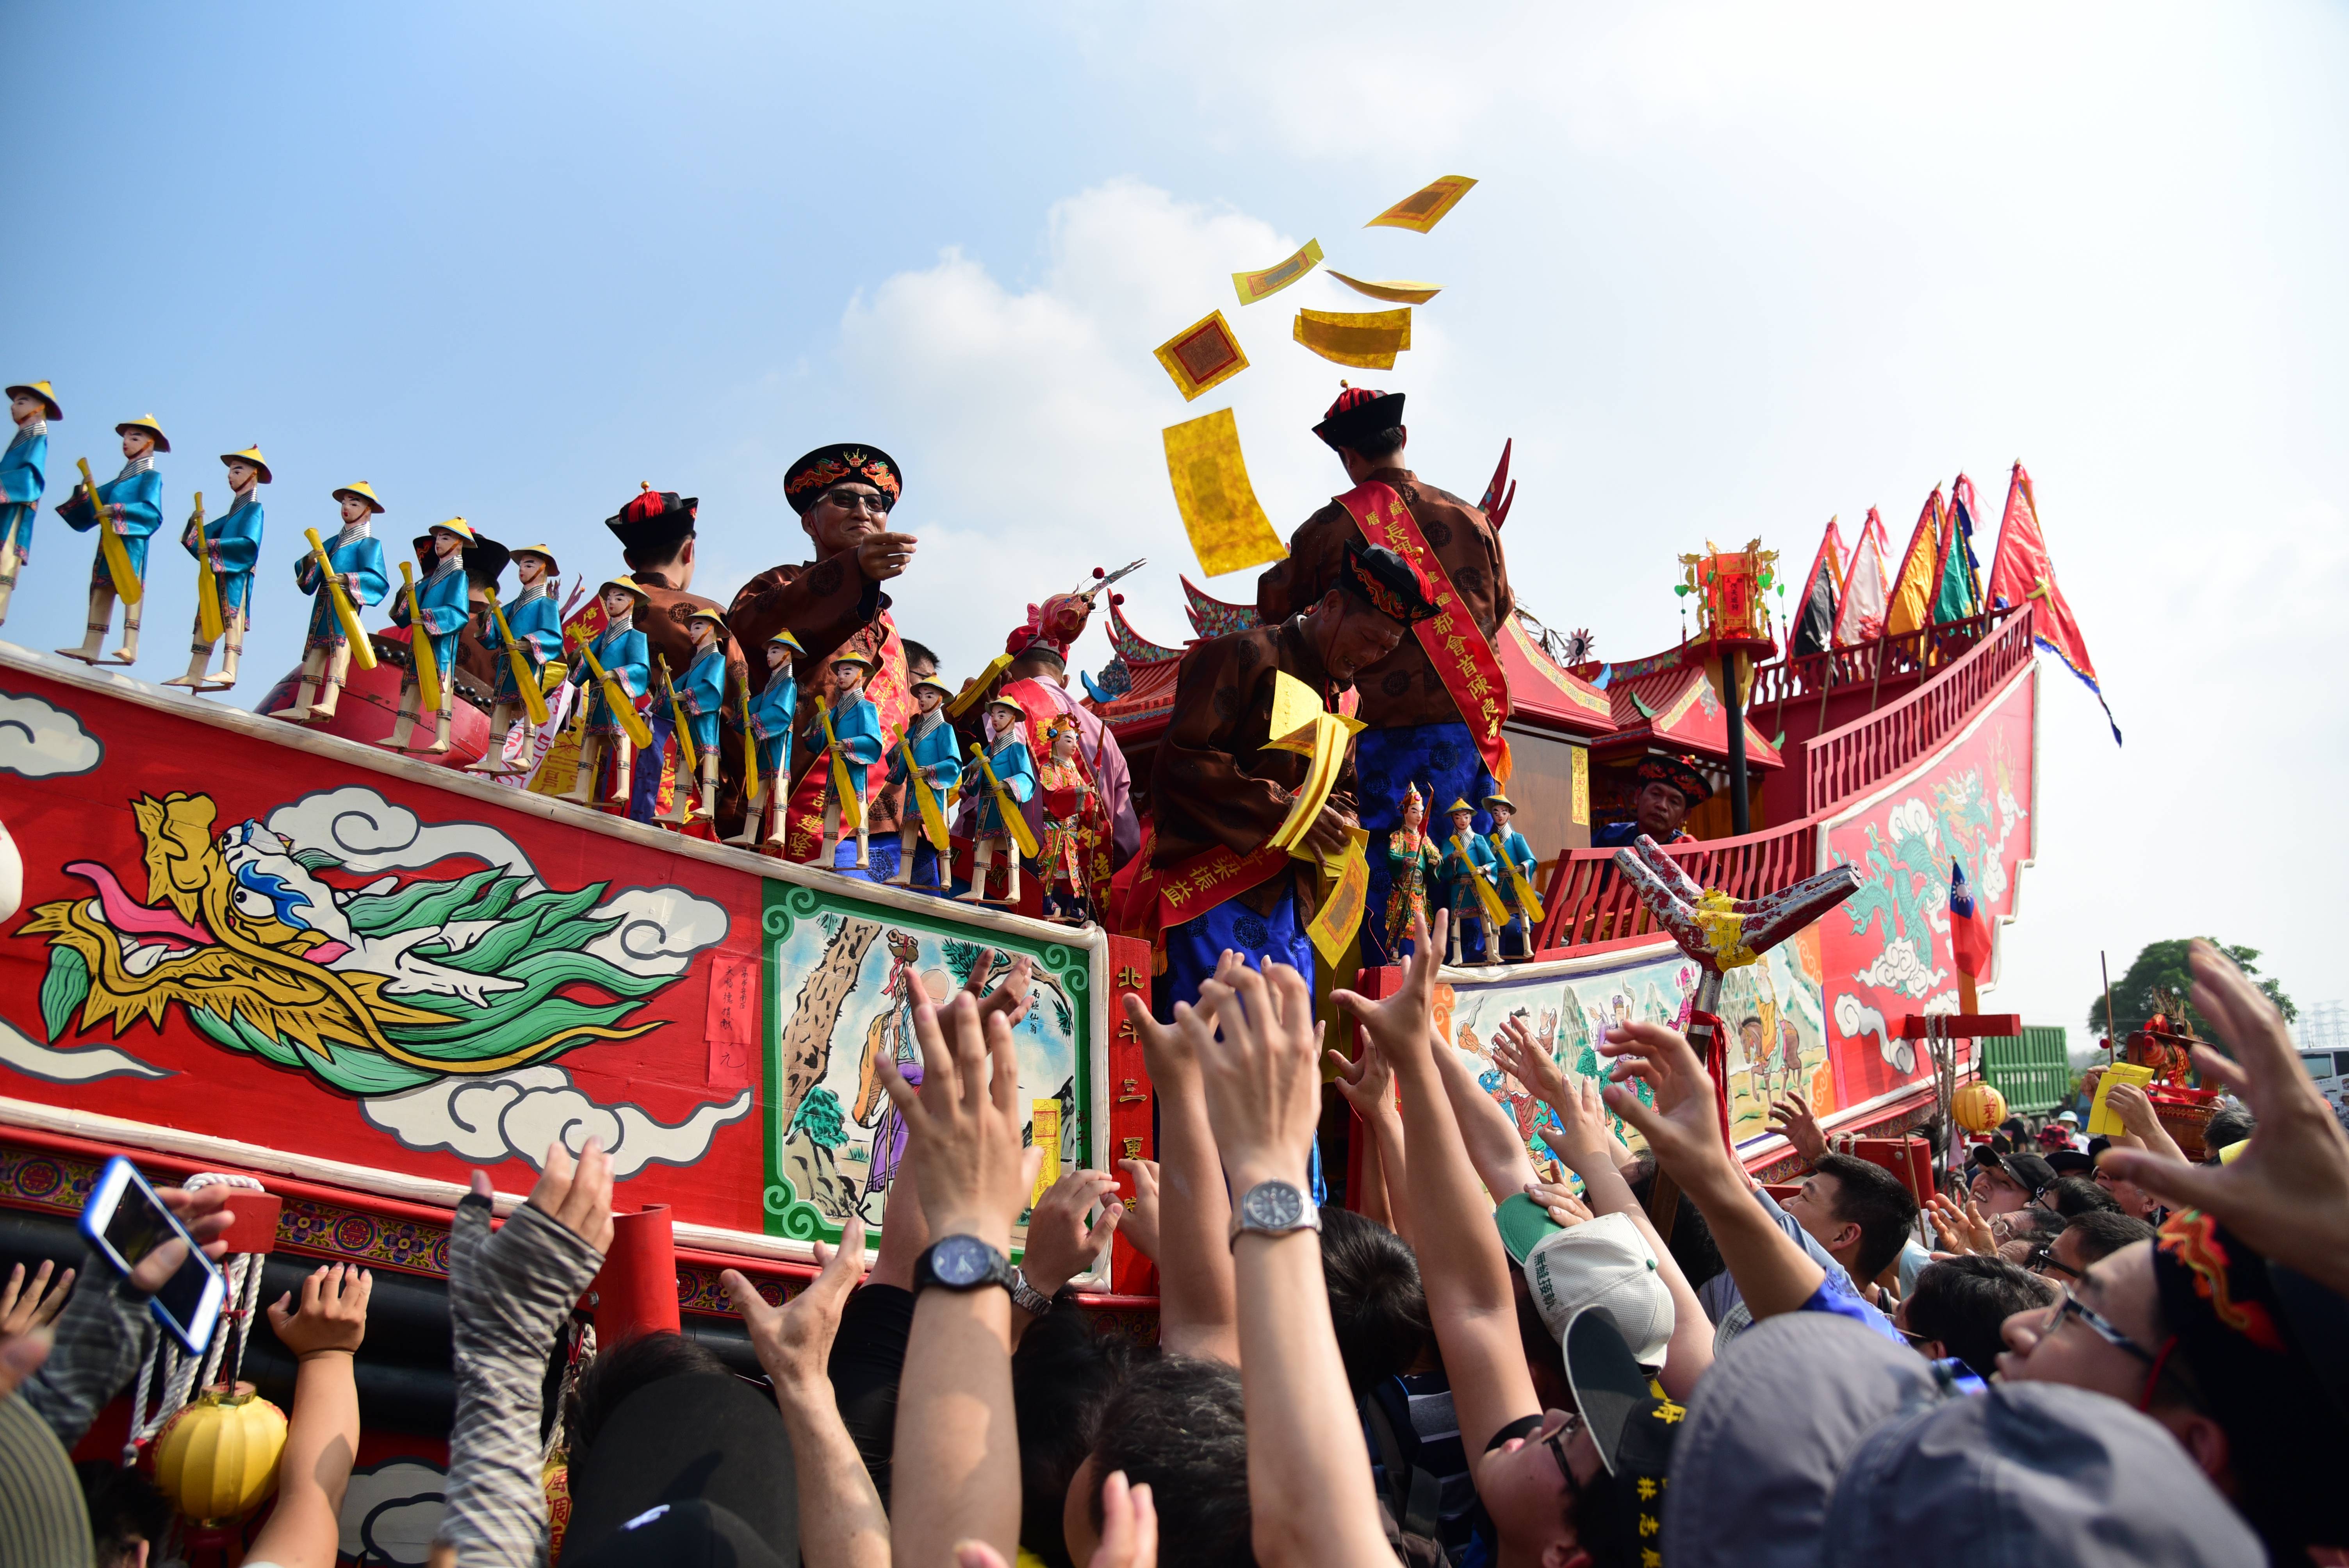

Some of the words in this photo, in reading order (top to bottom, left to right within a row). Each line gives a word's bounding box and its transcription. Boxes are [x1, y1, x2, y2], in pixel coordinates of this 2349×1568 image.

[1030, 988, 1040, 1034] 南極仙翁
[1534, 1251, 1557, 1311] 無縫接軌
